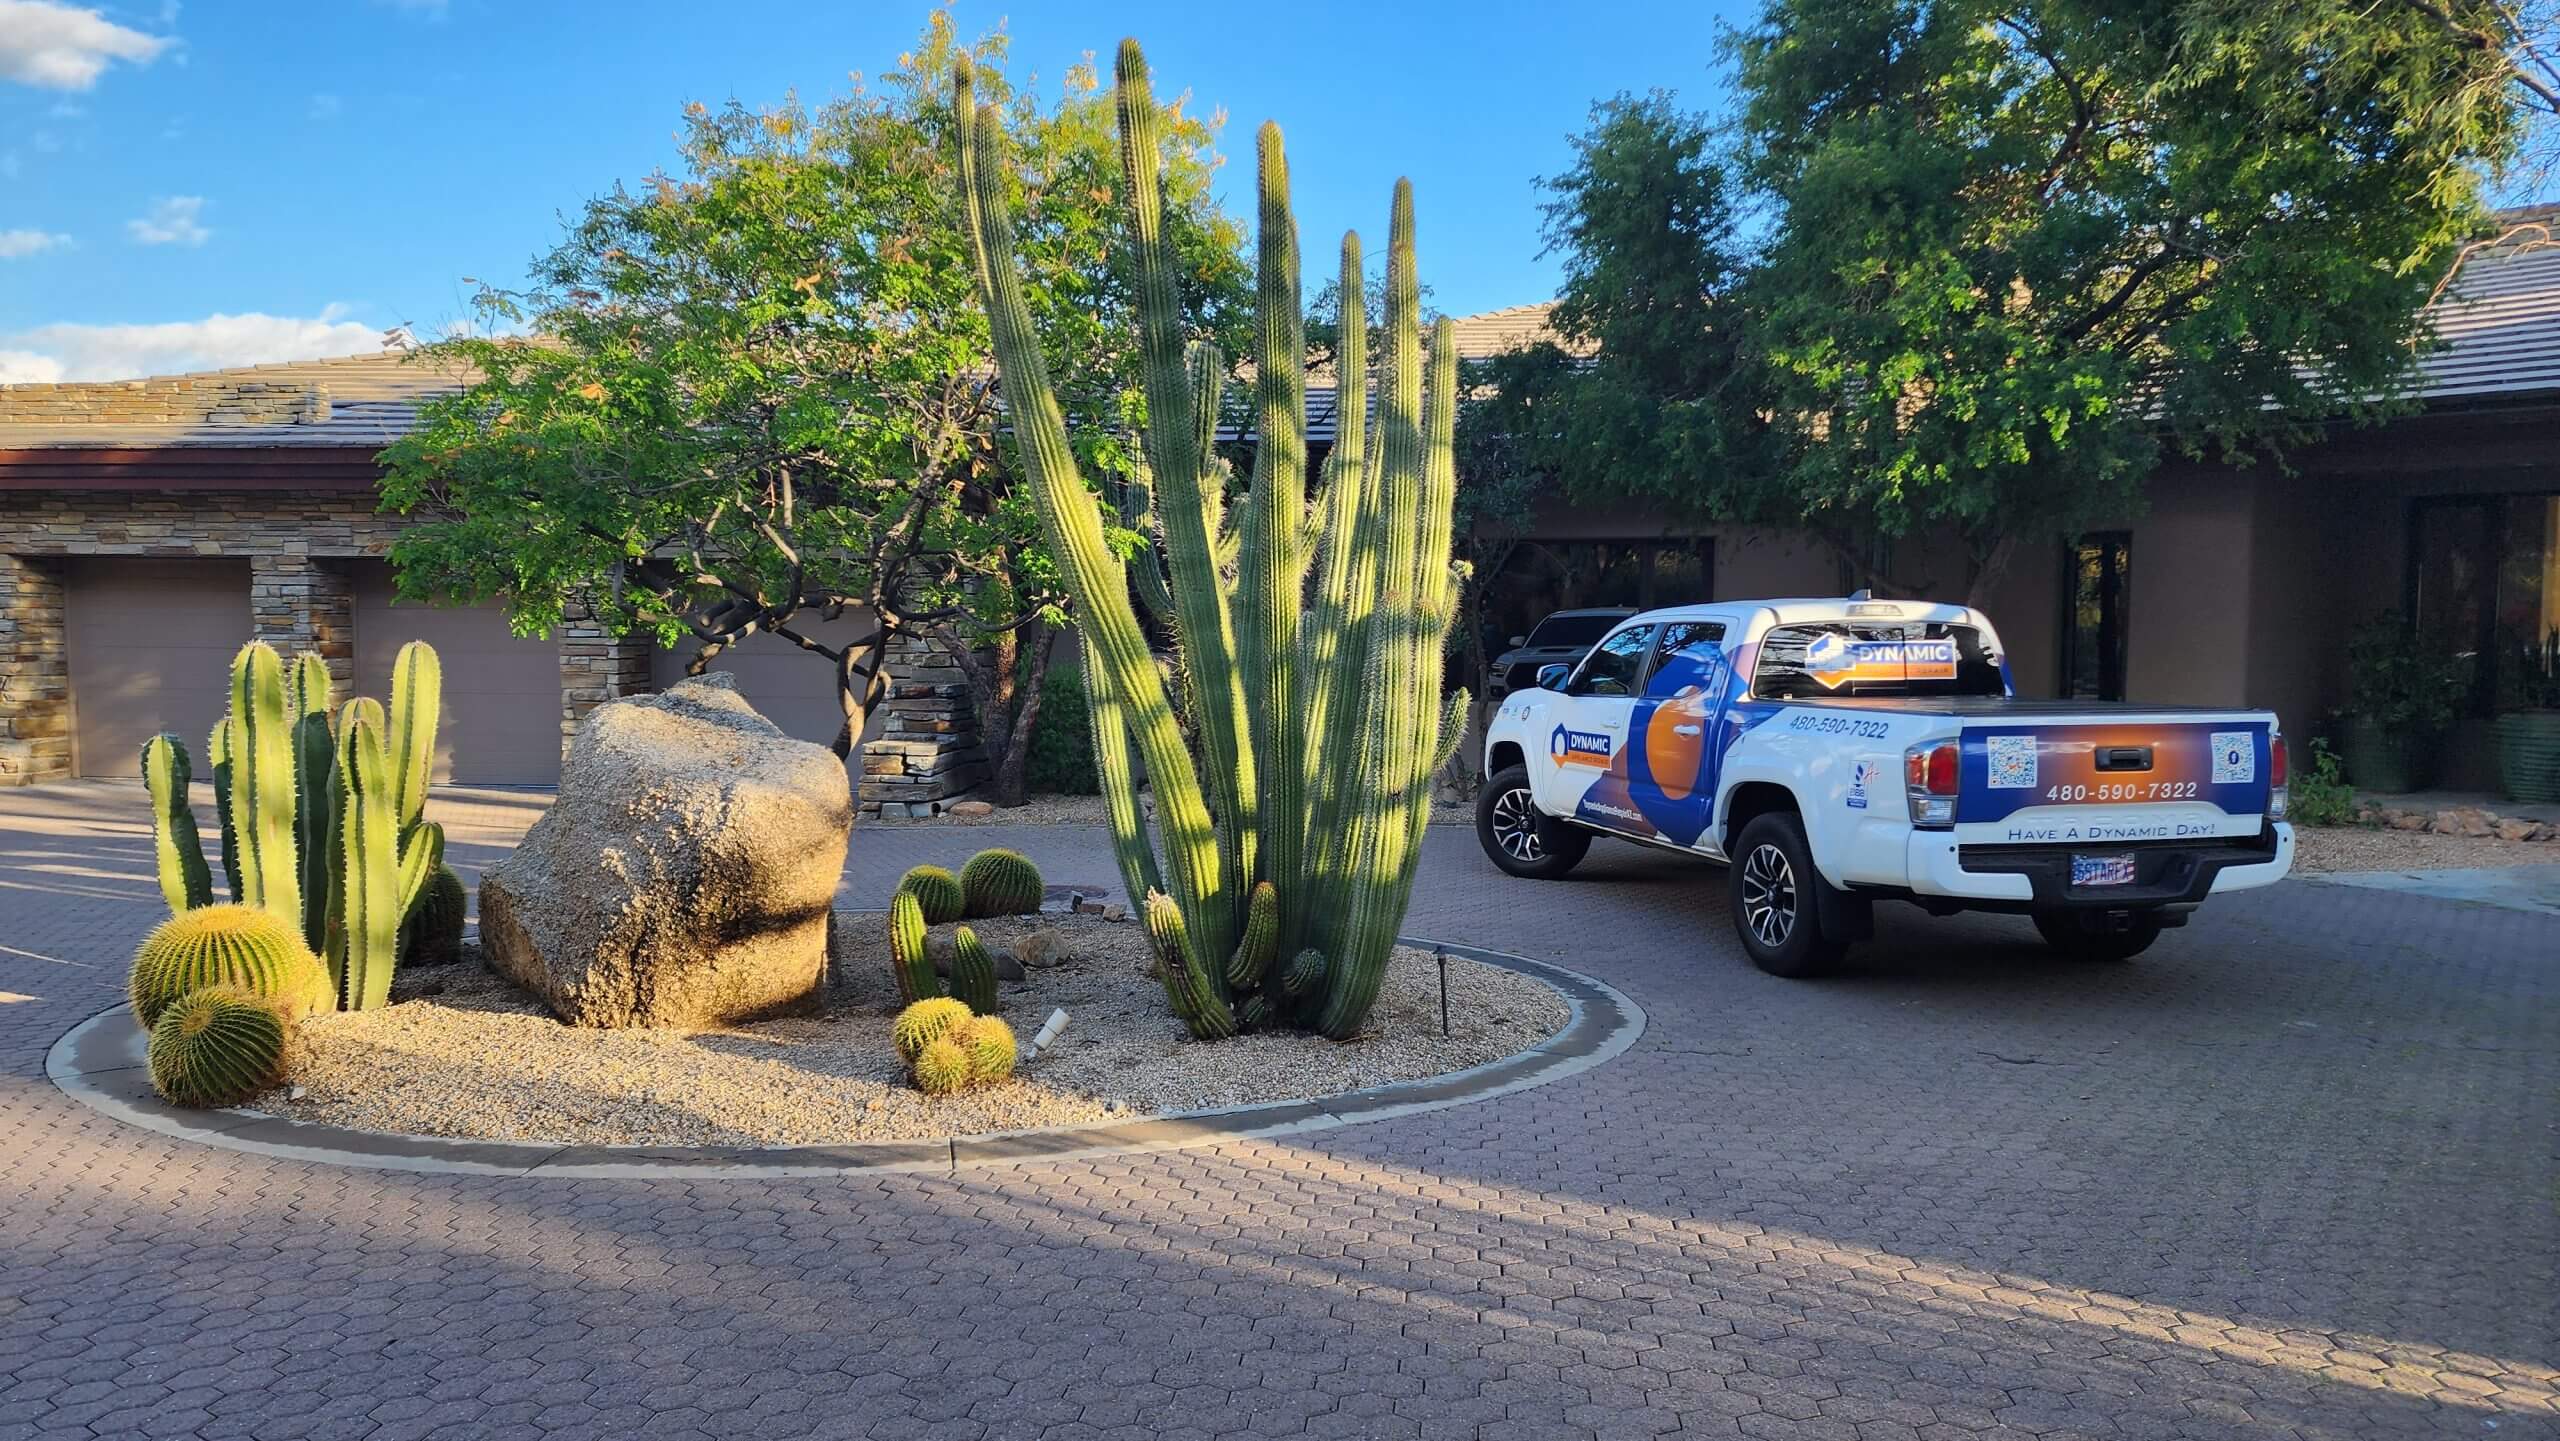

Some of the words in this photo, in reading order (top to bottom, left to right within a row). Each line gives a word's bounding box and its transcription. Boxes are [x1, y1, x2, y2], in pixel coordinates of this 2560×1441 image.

[1860, 646, 1948, 661] DYNAMIC
[1790, 715, 1889, 739] 480-590-7322
[1571, 735, 1609, 752] DYNAMIC
[2046, 782, 2197, 800] 480-590-7322
[2066, 828, 2079, 839] A
